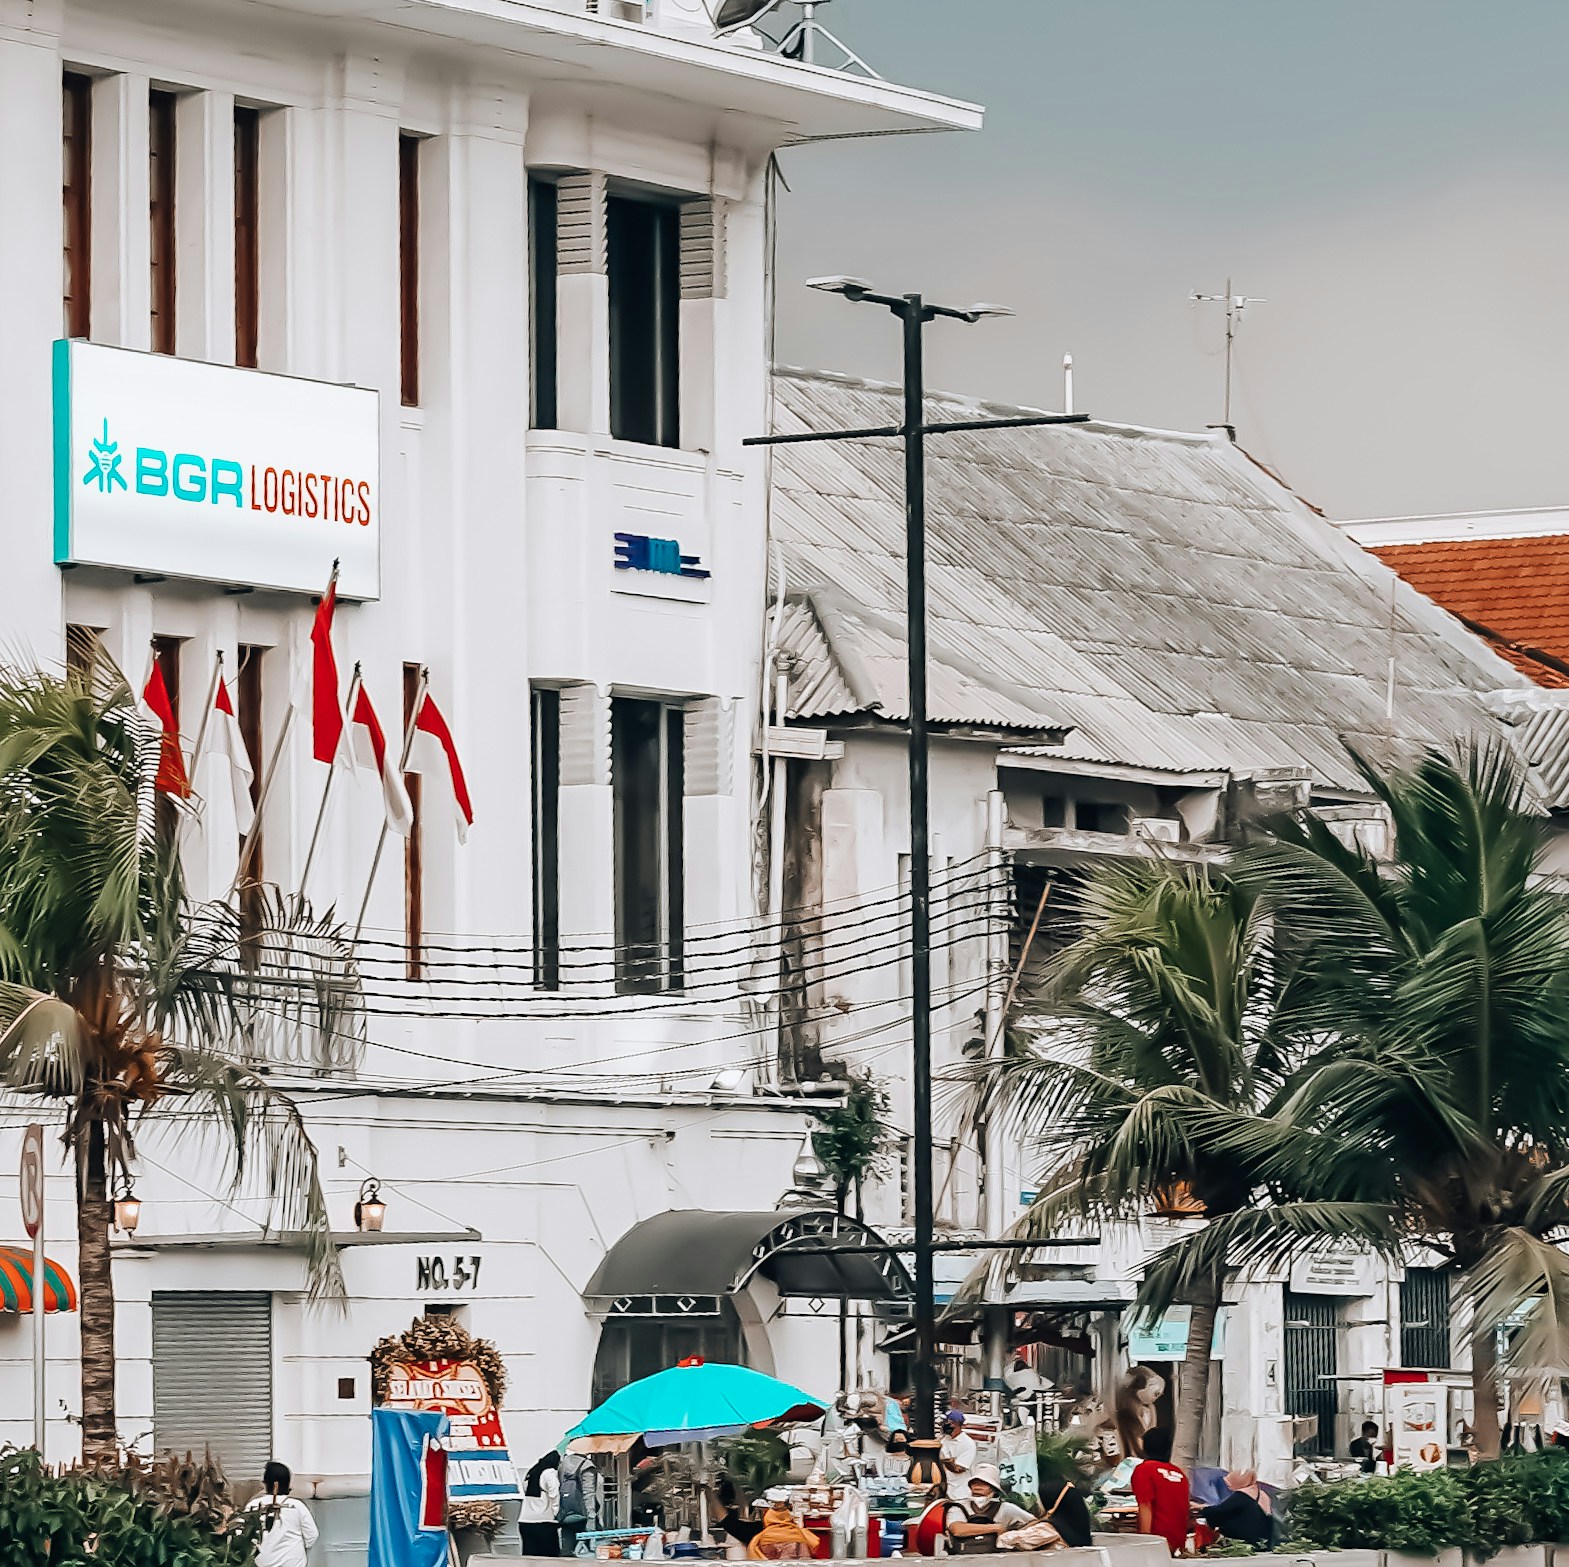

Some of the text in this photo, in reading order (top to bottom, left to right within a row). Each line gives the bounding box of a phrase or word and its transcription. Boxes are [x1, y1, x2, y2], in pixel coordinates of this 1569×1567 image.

[135, 447, 371, 527] BGR LOGISTICS
[416, 1256, 482, 1290] NO. 5-7
